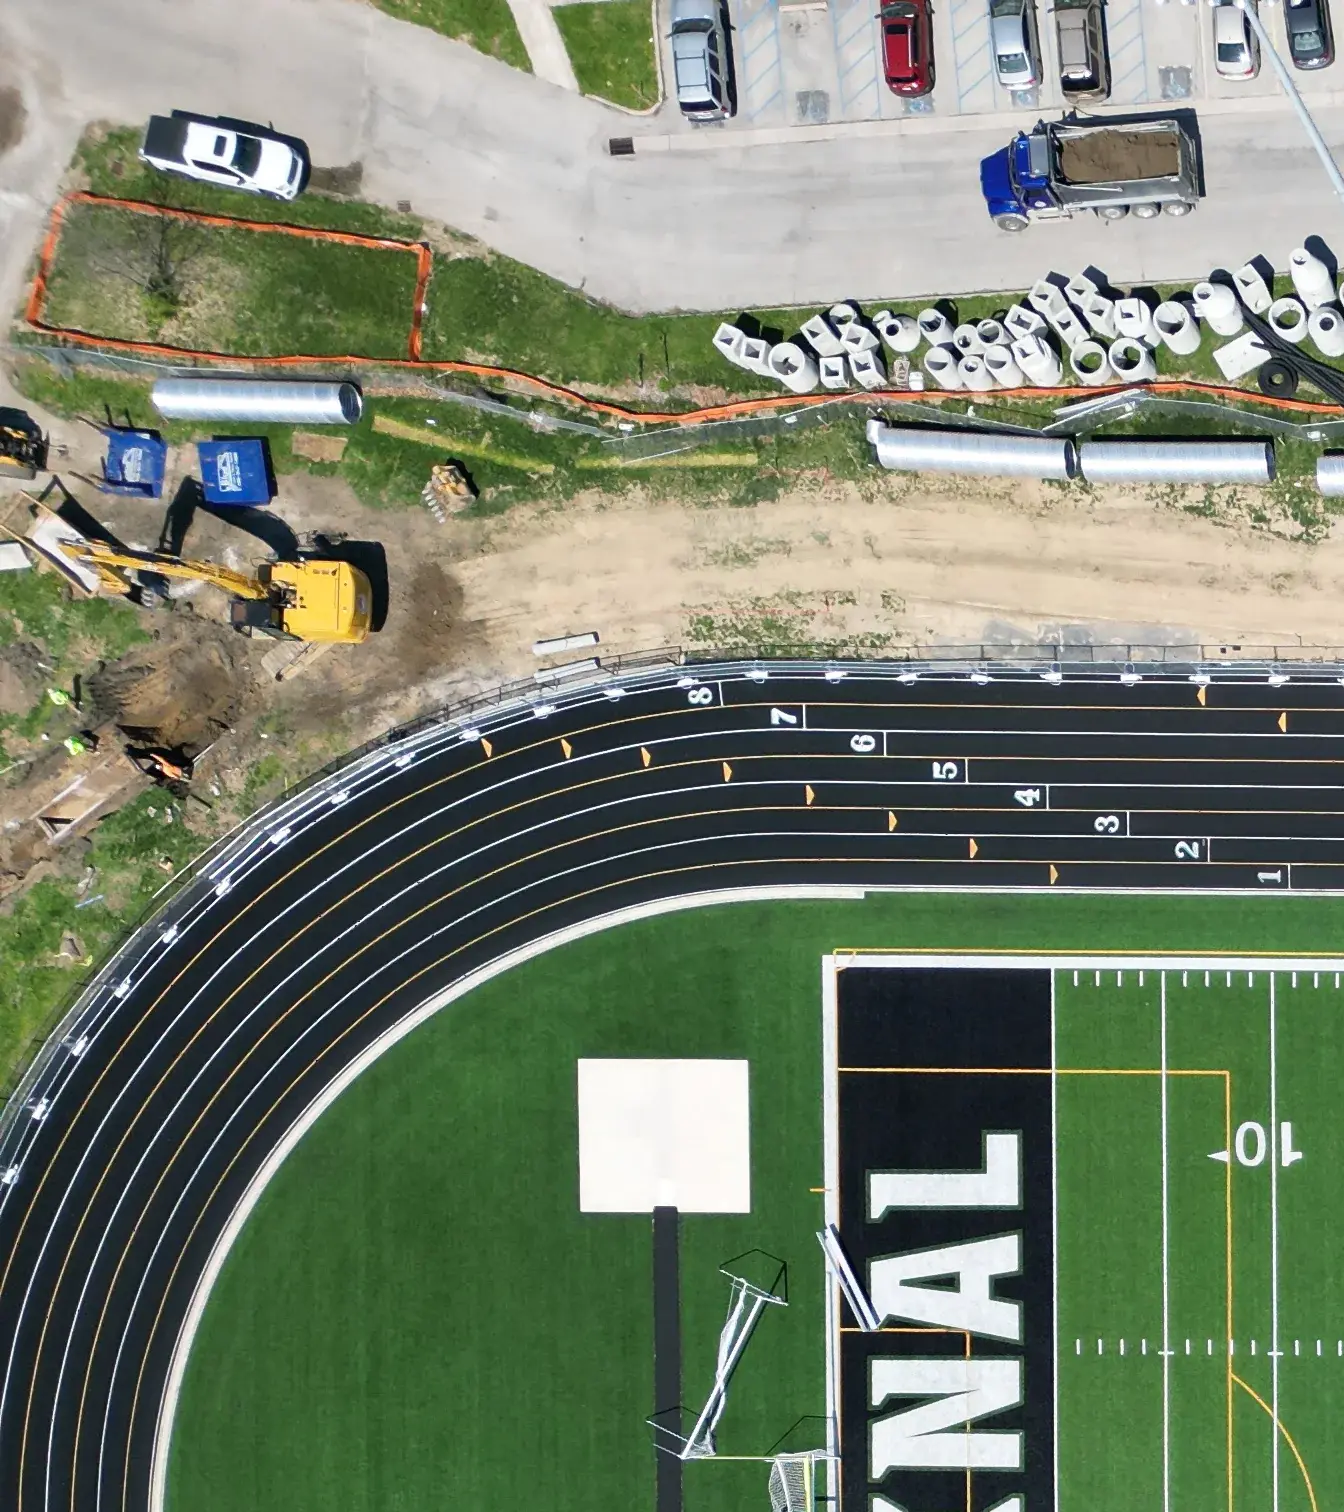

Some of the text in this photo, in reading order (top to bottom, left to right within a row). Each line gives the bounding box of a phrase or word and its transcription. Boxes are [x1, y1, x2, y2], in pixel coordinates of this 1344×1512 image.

[687, 686, 713, 705] 8
[770, 707, 798, 726] 7
[849, 734, 876, 753] 6
[931, 761, 958, 780] 5
[1013, 788, 1041, 807] 4
[1093, 814, 1120, 834] 3
[1174, 840, 1200, 860] 2
[1256, 869, 1282, 884] 1
[1235, 1121, 1303, 1167] 10
